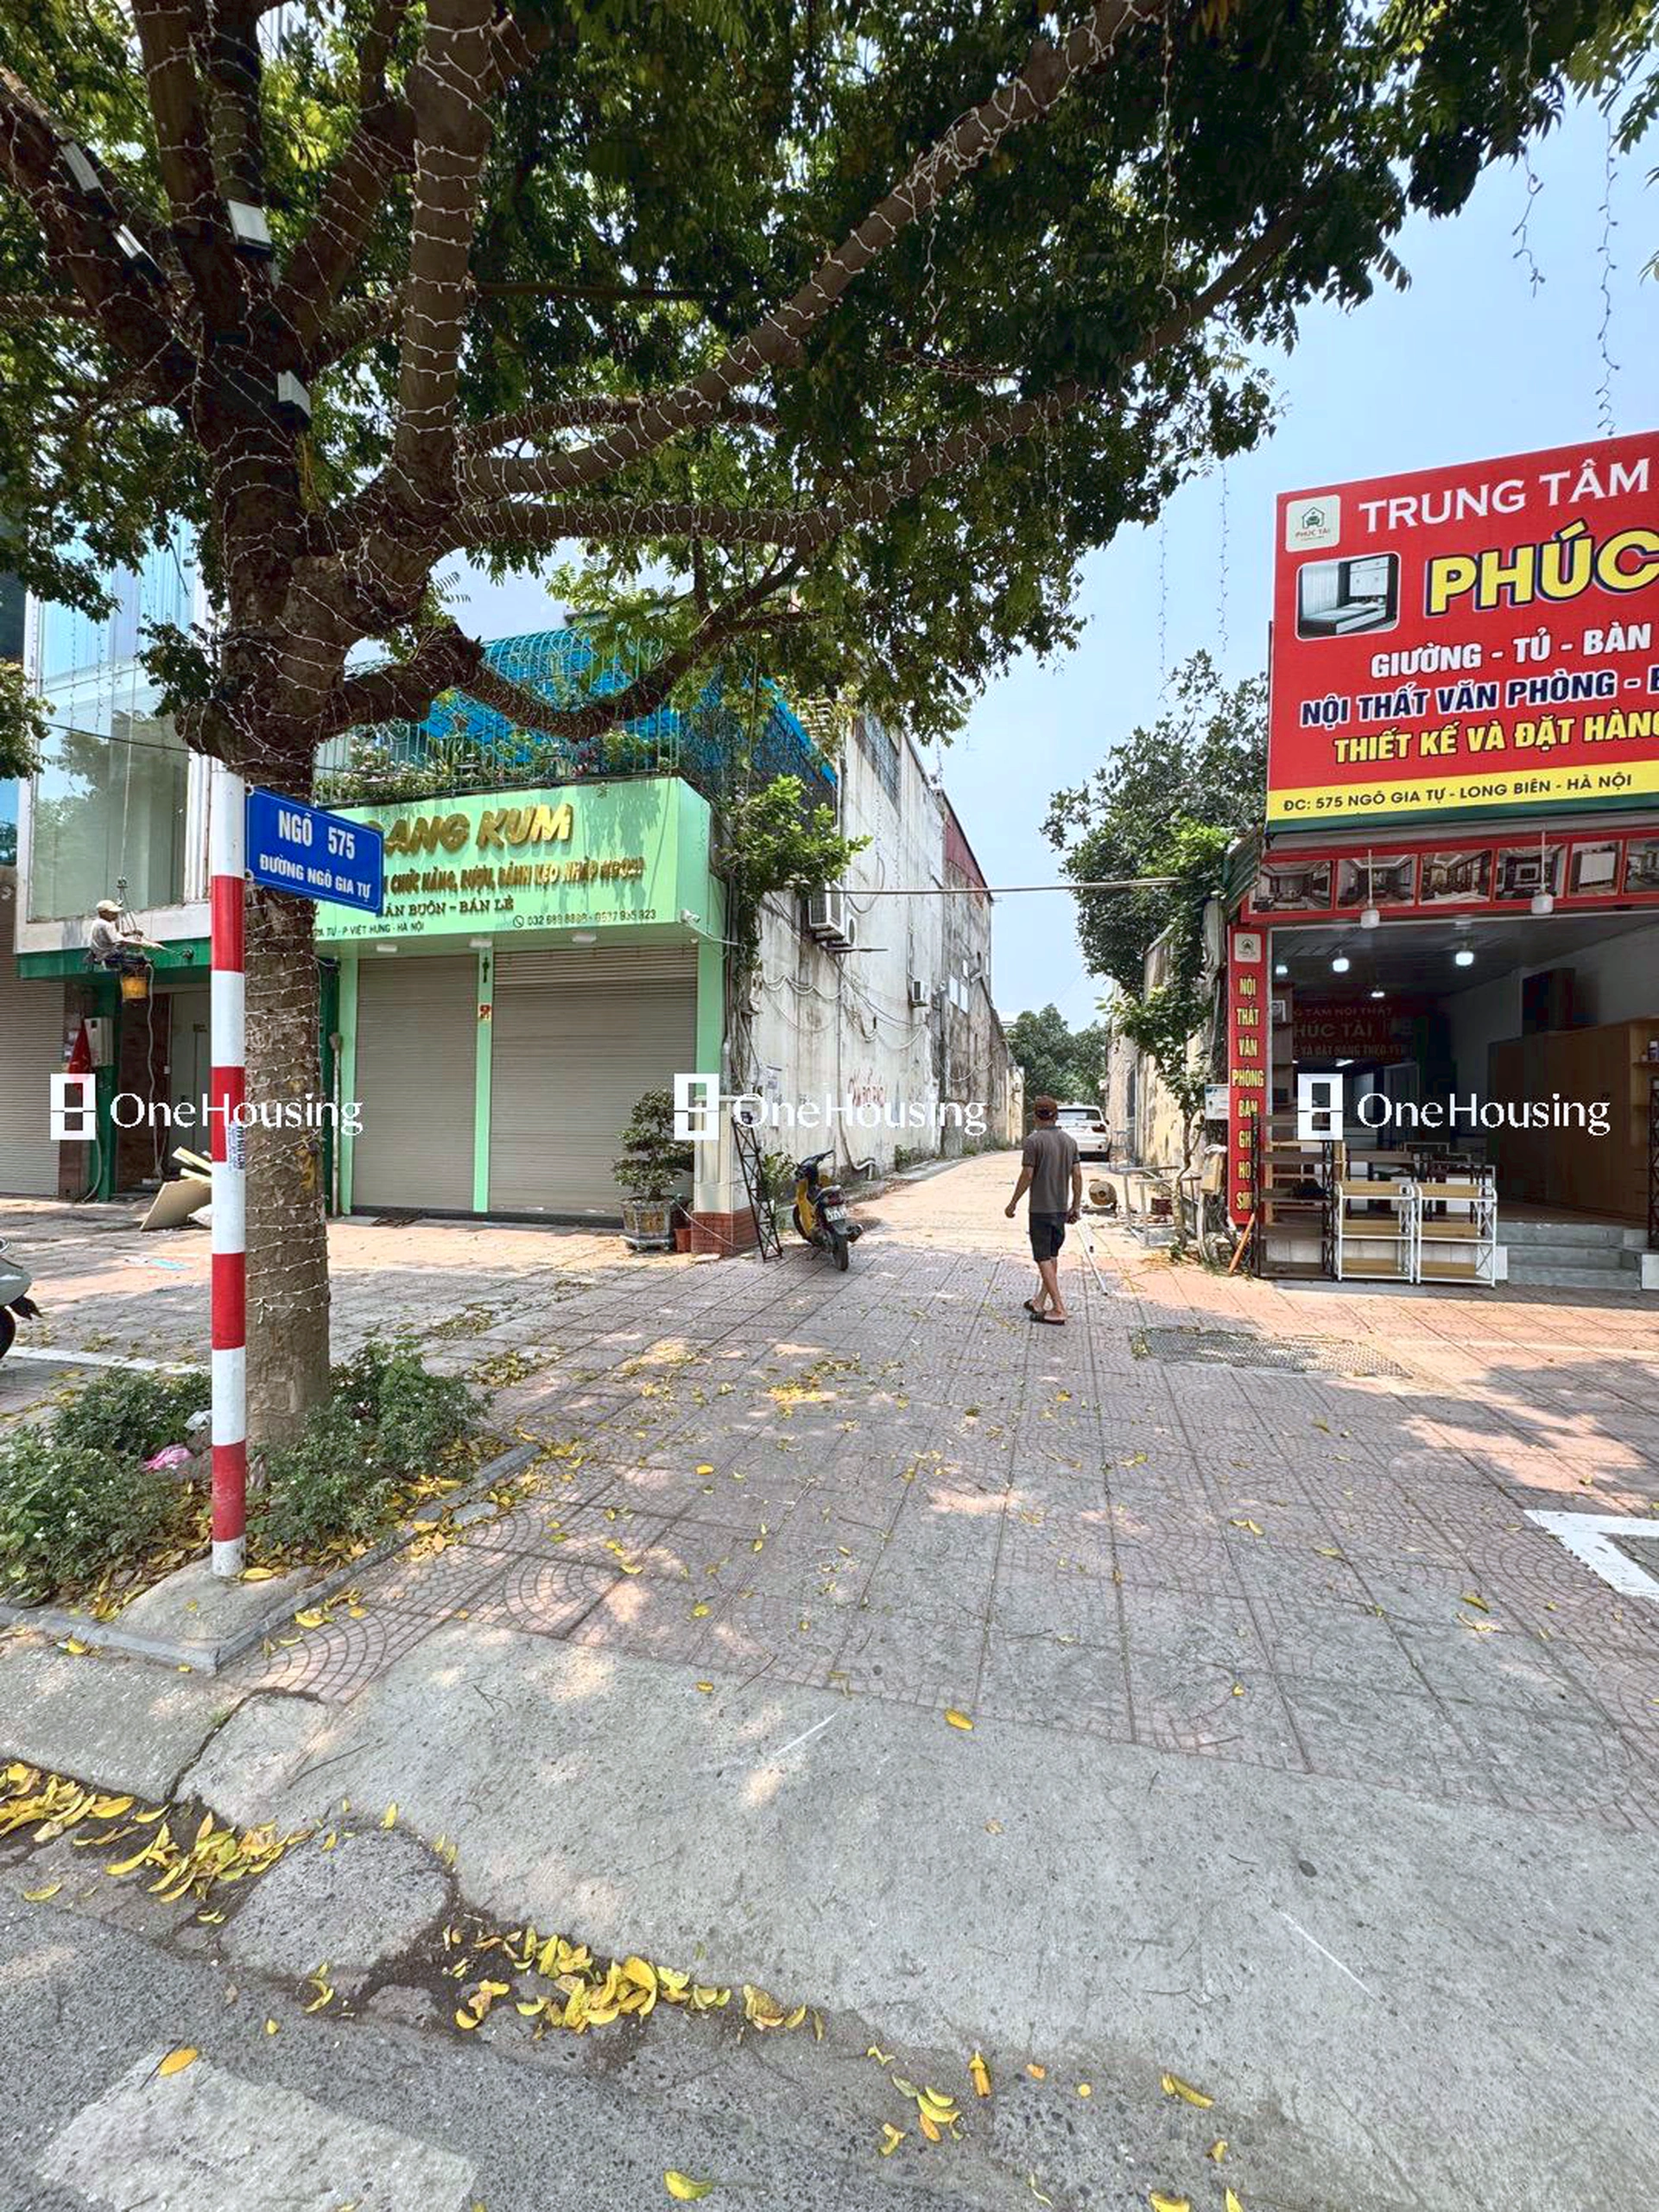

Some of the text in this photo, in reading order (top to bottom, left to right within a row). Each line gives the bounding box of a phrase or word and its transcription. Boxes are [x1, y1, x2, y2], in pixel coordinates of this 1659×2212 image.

[1358, 458, 1650, 533] TRUNG TÂM
[1428, 517, 1659, 617] PHÚC
[1371, 643, 1482, 679] GIƯỜNG
[1513, 628, 1552, 663] TỦ
[1583, 622, 1652, 656] BÀN
[1301, 694, 1350, 734] NỘI
[1357, 683, 1428, 722] THẤT
[1437, 679, 1498, 715] VĂN
[1506, 667, 1618, 707] PHÒNG
[1334, 727, 1412, 764] THIẾT
[1419, 721, 1460, 757] KẾ
[1467, 719, 1506, 753] VÀ
[1514, 715, 1575, 752] ĐẶT
[1284, 799, 1310, 812] ĐC:
[1315, 795, 1344, 808] 575
[1348, 791, 1386, 807] NGÔ
[1392, 789, 1421, 803] GIA
[1426, 786, 1446, 804] TỰ
[1460, 783, 1507, 800] LONG
[1514, 776, 1552, 795] BIÊN
[1567, 774, 1593, 790] HÀ
[1599, 771, 1632, 790] NỘI
[278, 809, 356, 860] NGÕ 575
[476, 802, 573, 852] KUM
[260, 852, 305, 881] ĐƯỜNG
[307, 868, 332, 889] NGÔ
[335, 876, 354, 895] GIA
[356, 881, 371, 903] TỰ
[385, 903, 404, 917] ÁN
[459, 897, 491, 914] BÁN
[1239, 974, 1257, 1000] NỘI
[1237, 1001, 1259, 1025] THẤT
[1232, 1066, 1264, 1087] PHÒNG
